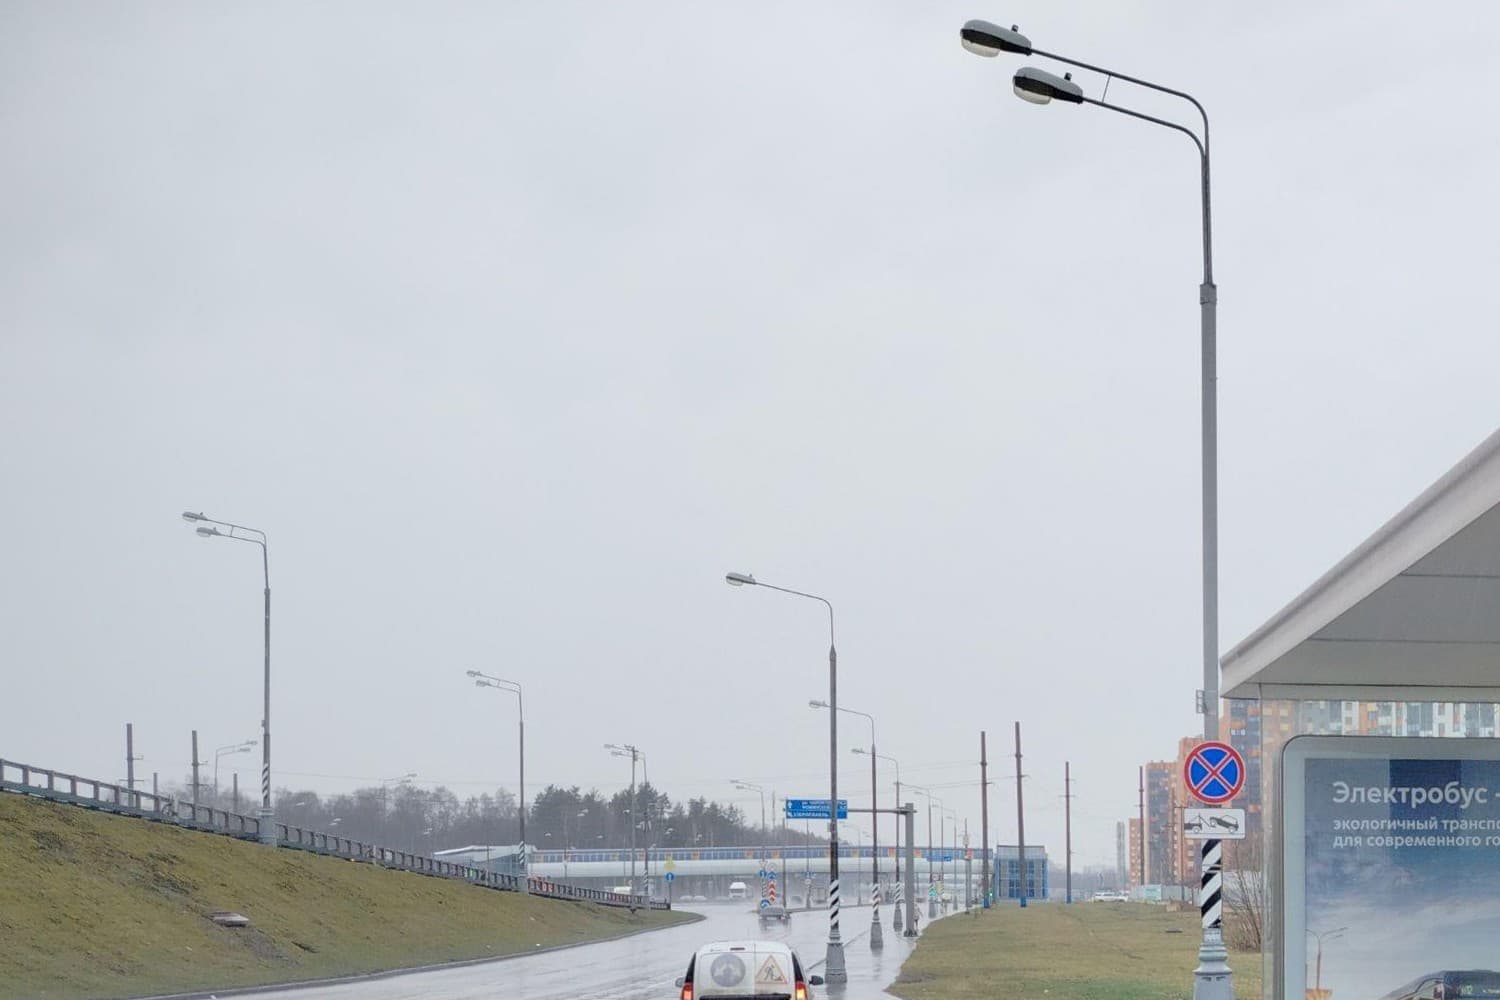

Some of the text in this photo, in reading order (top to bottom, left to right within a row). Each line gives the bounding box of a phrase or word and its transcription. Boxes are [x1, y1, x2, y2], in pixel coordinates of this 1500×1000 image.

[1332, 781, 1488, 809] Электробус
[1333, 816, 1438, 830] экологичный
[1333, 836, 1362, 848] для
[1367, 836, 1481, 849] современного
